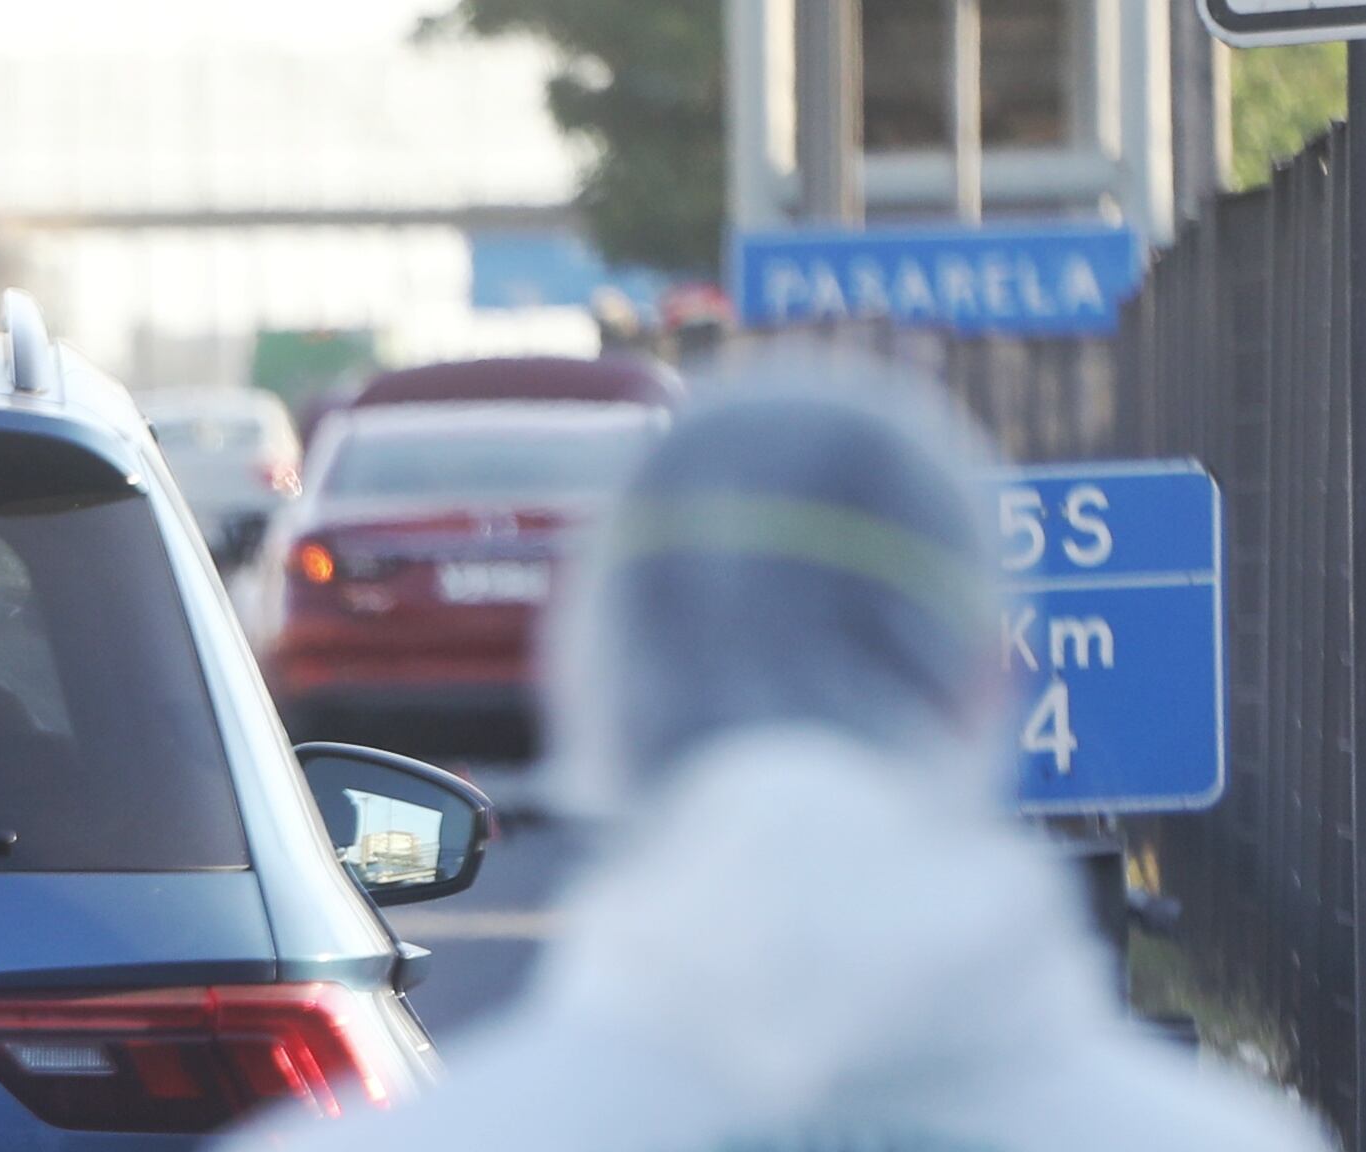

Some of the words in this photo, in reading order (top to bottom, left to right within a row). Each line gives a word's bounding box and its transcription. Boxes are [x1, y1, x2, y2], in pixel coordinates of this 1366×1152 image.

[765, 252, 1105, 320] PASARELA
[999, 606, 1114, 672] Km
[1023, 678, 1078, 775] 4
